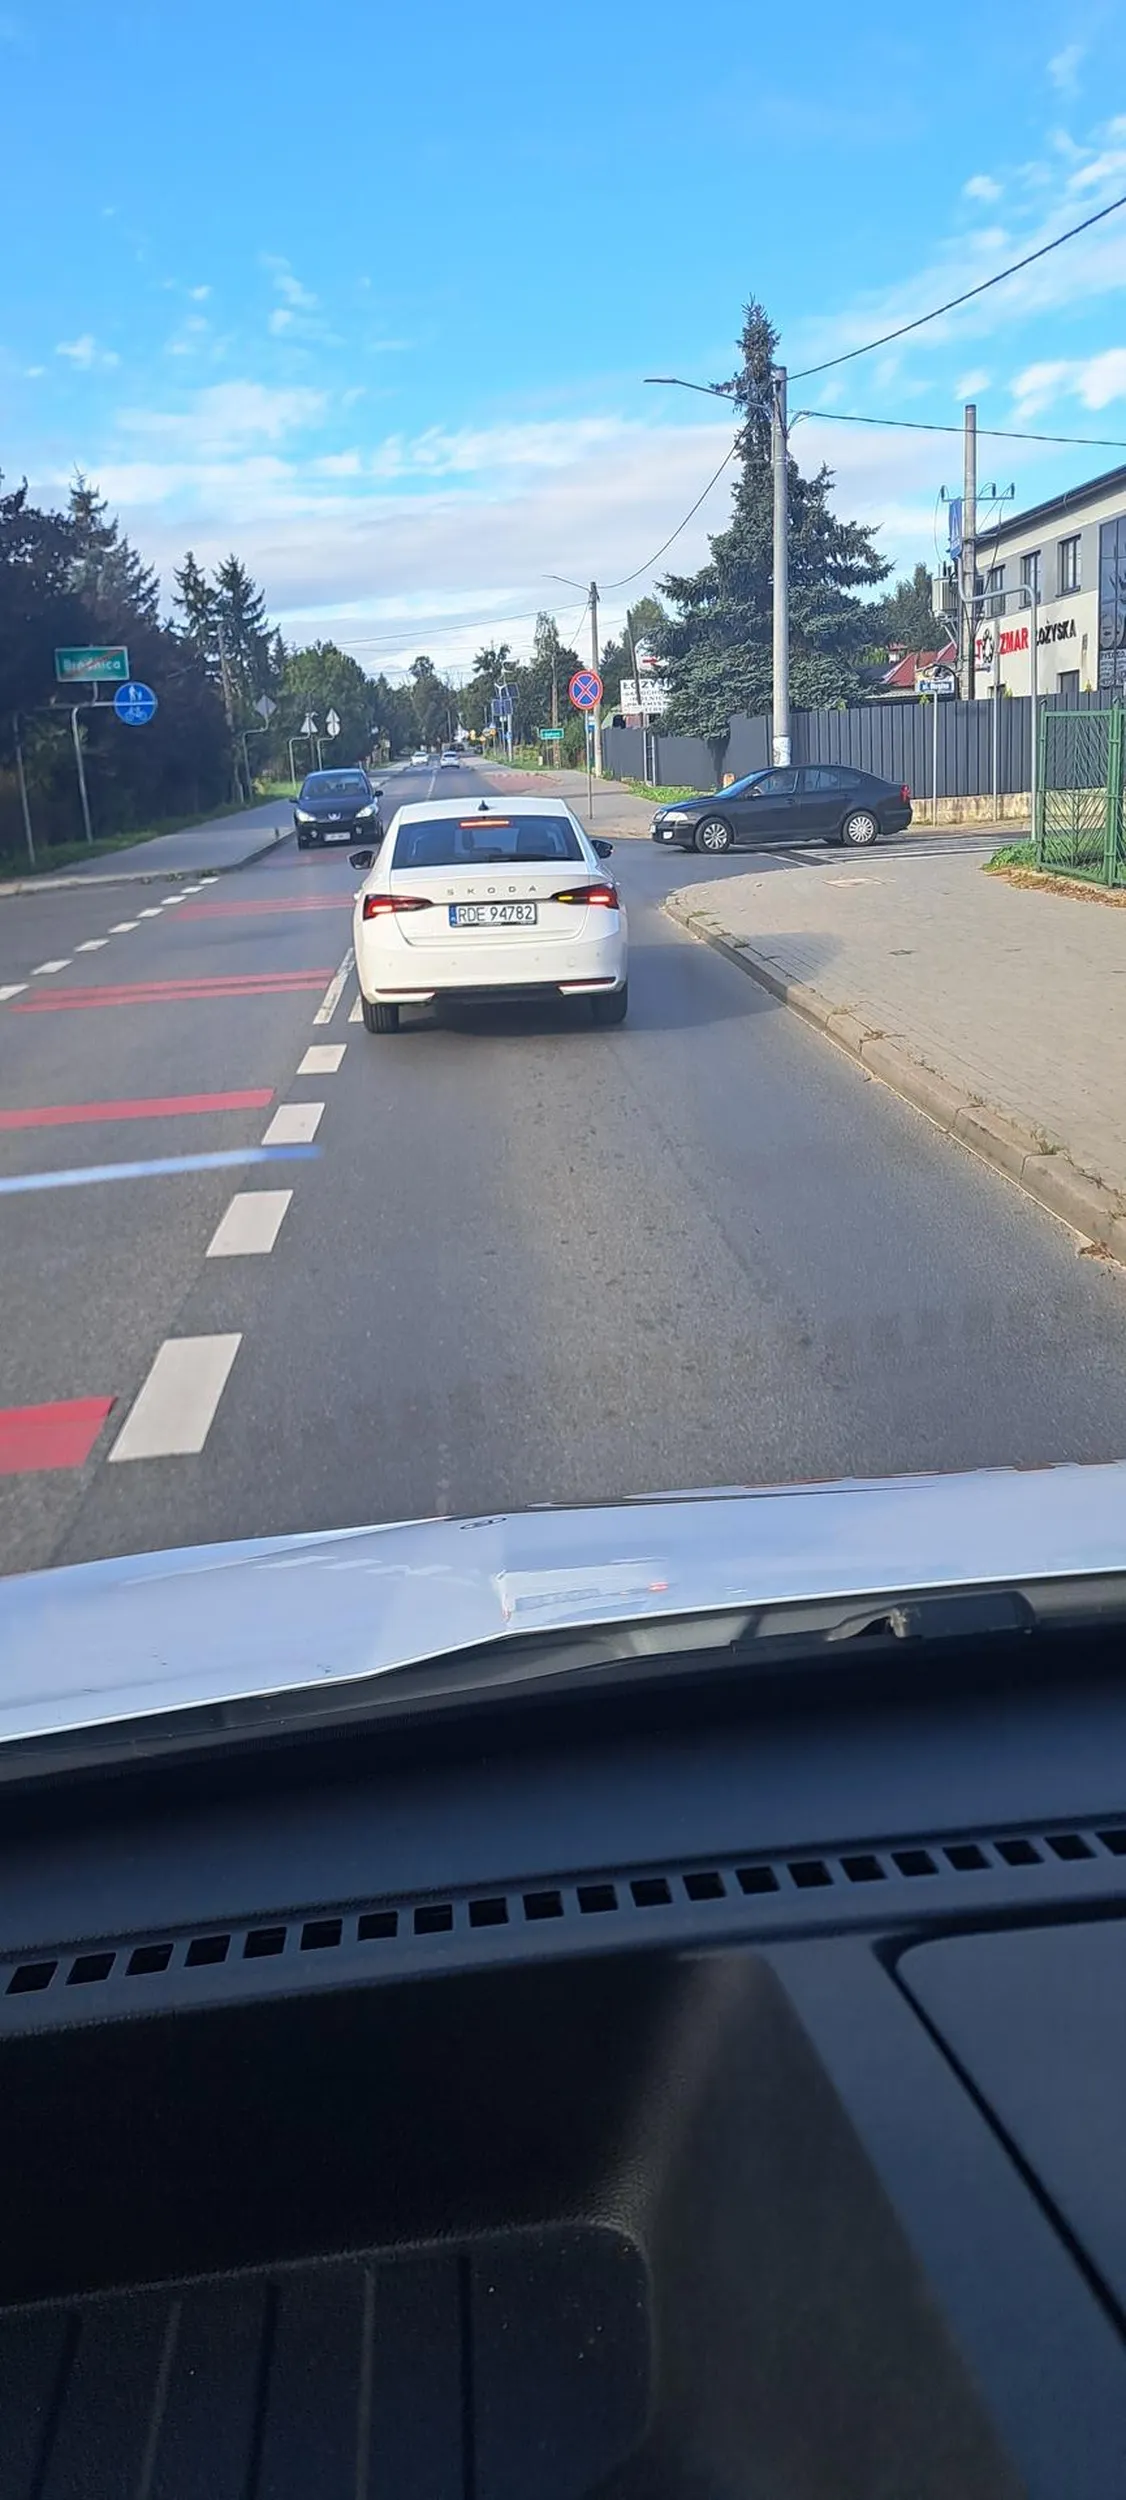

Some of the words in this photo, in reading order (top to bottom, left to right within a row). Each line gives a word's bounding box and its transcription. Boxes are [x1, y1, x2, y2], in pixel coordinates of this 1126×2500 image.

[447, 886, 537, 896] SKODA
[458, 906, 485, 922] RDE
[490, 904, 533, 921] 94782
